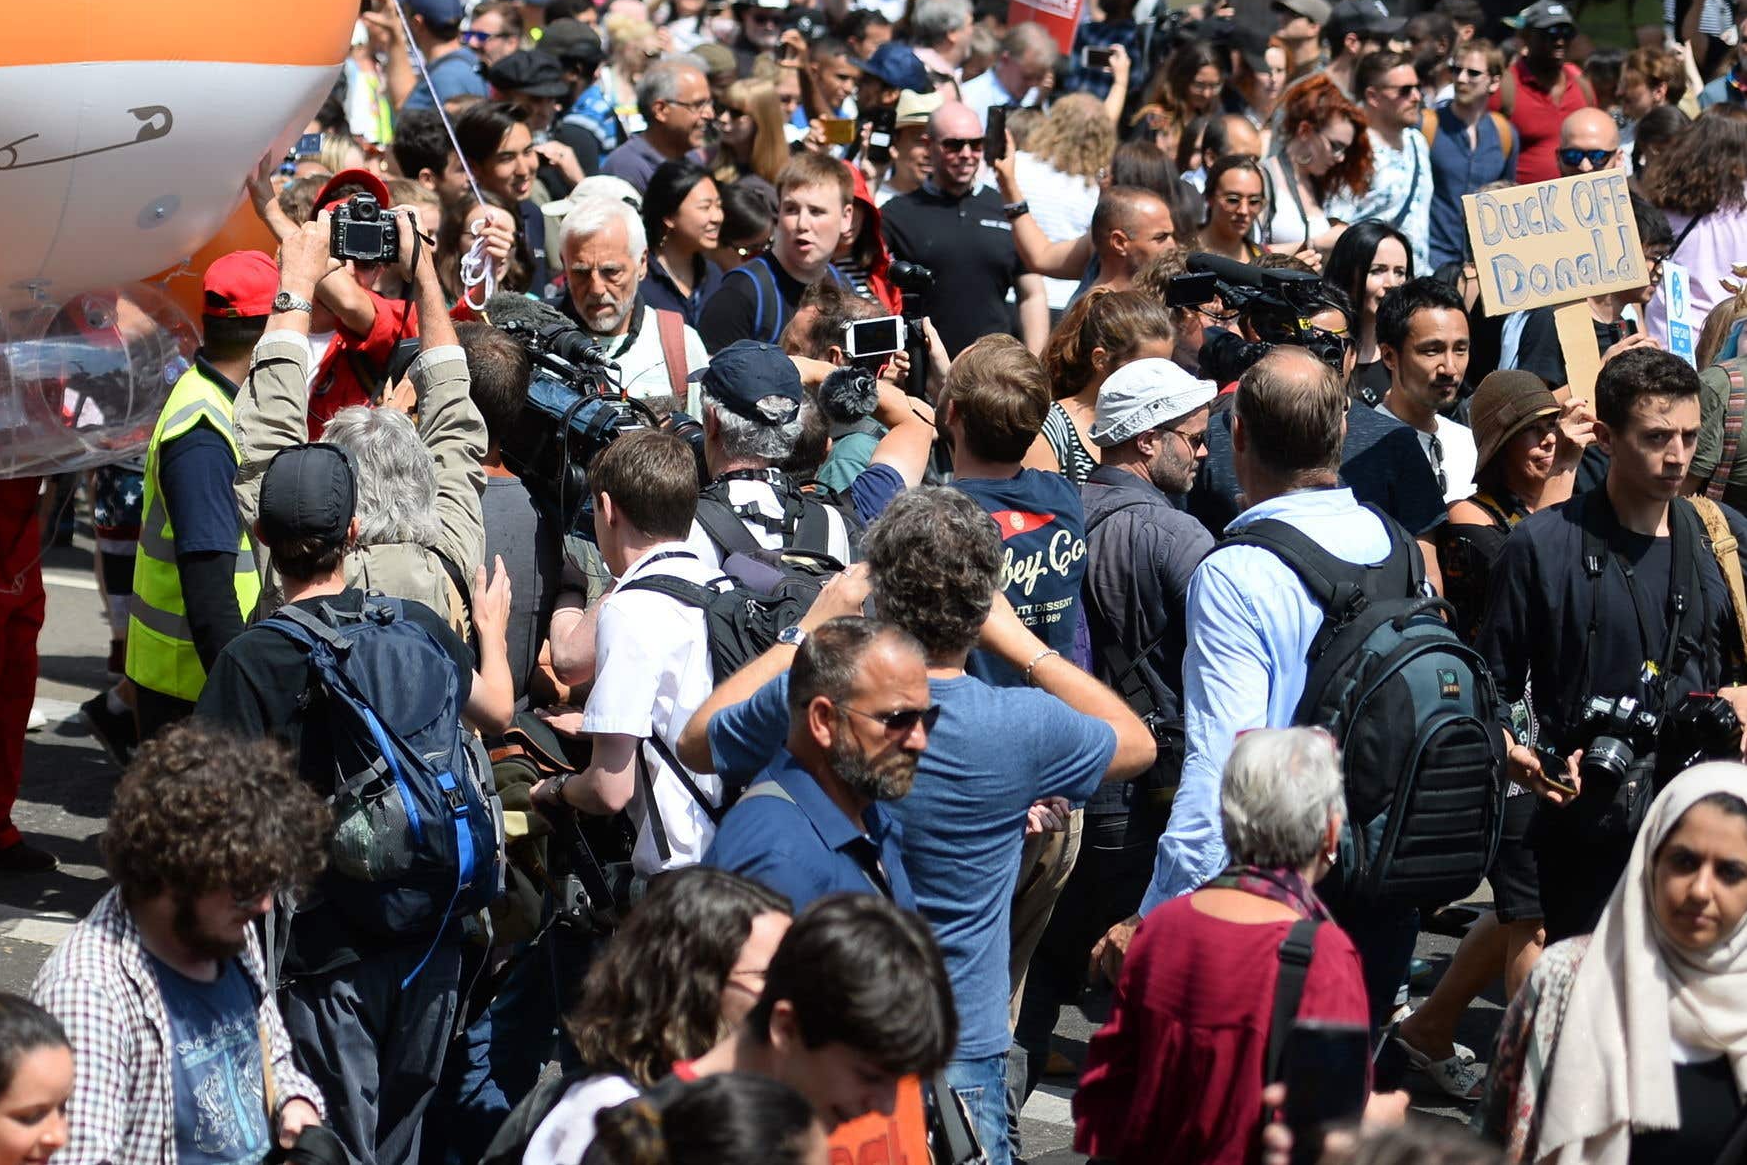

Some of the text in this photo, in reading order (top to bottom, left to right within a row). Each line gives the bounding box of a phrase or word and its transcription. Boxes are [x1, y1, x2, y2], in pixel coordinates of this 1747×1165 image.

[1570, 175, 1629, 228] OFF
[1035, 596, 1074, 613] DISSENT
[1041, 612, 1062, 624] 1989
